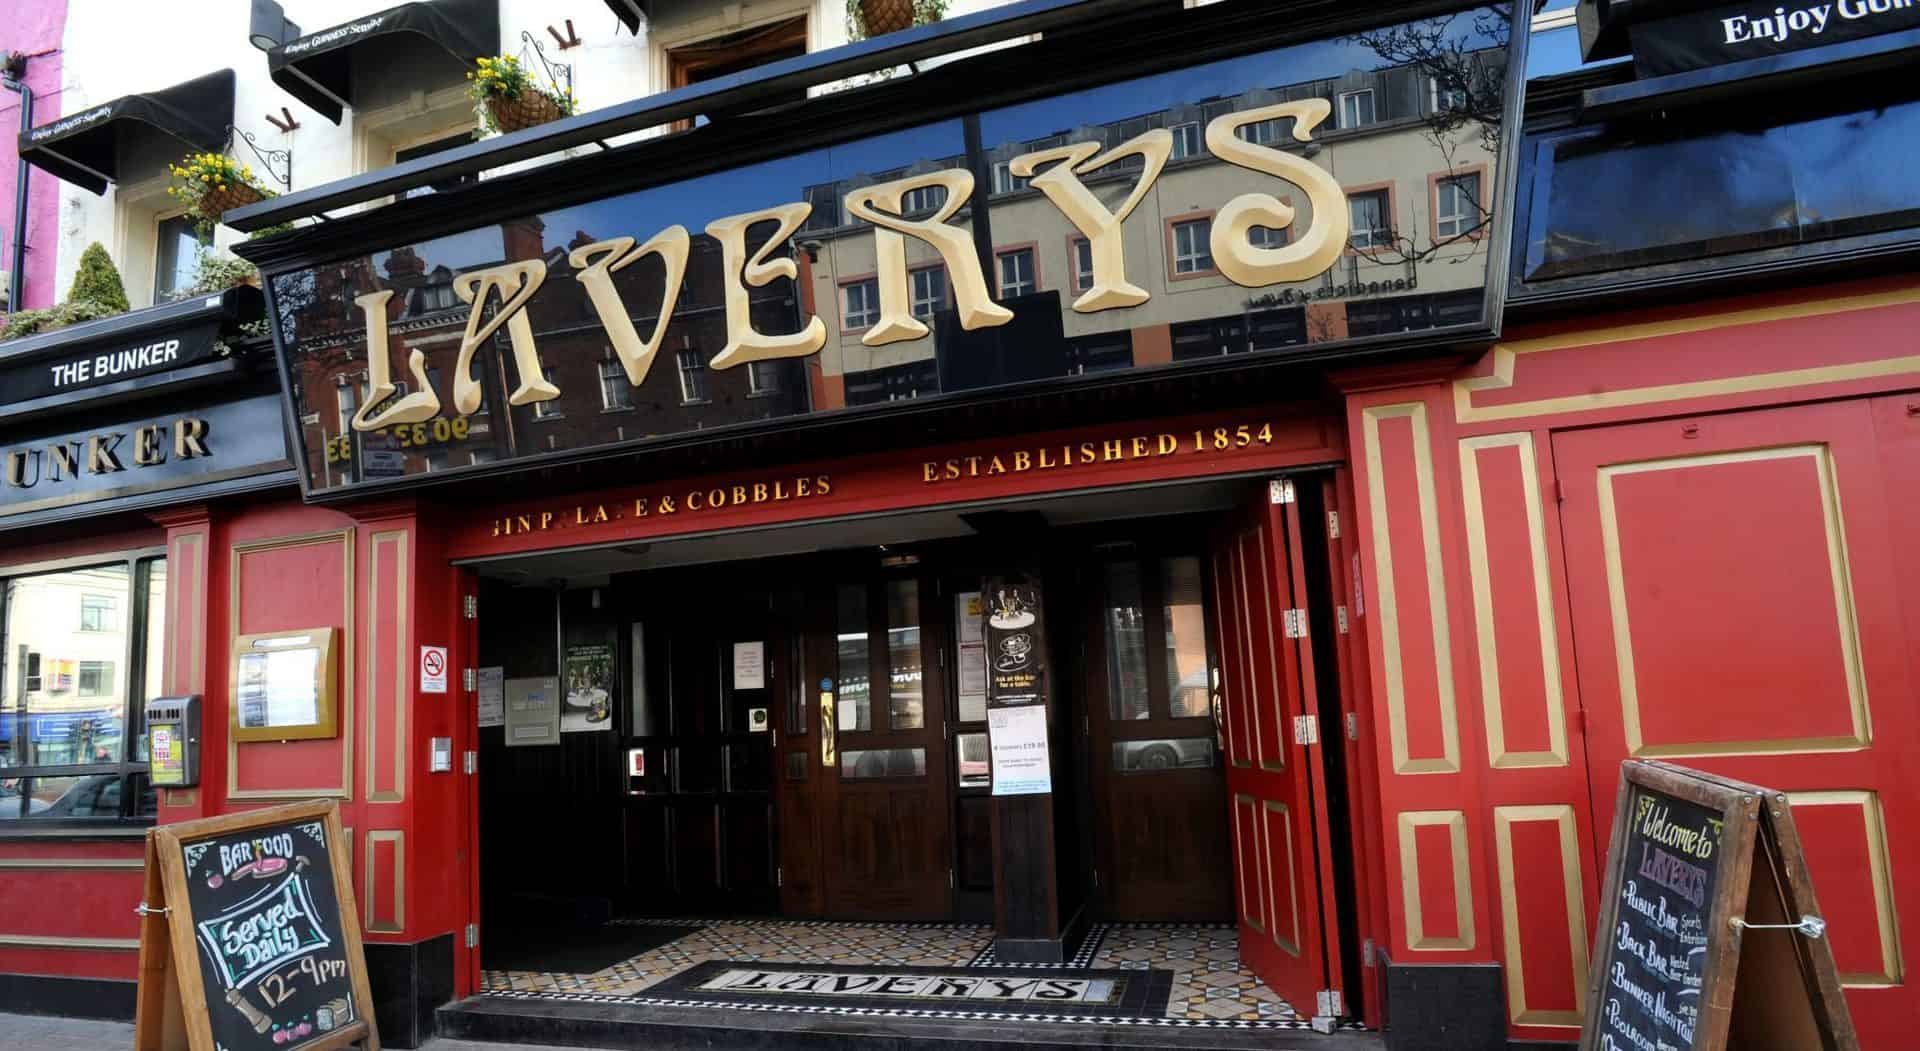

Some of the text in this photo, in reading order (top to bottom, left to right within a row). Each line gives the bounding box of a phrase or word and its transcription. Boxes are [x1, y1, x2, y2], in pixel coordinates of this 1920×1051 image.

[1720, 4, 1832, 44] Enjoy
[352, 98, 1349, 431] LAVERYS
[51, 339, 180, 387] THE BUNKER
[0, 416, 213, 489] UNKER
[922, 422, 1274, 483] ESTABLISHED 1854
[541, 498, 649, 530] PLAE
[658, 495, 676, 514] &
[686, 474, 833, 512] COBBLES
[1642, 802, 1712, 858] Welcome to
[219, 841, 253, 876] BAR
[221, 886, 305, 955] Served
[239, 925, 300, 969] Daily
[740, 972, 1079, 1000] LAVERYS
